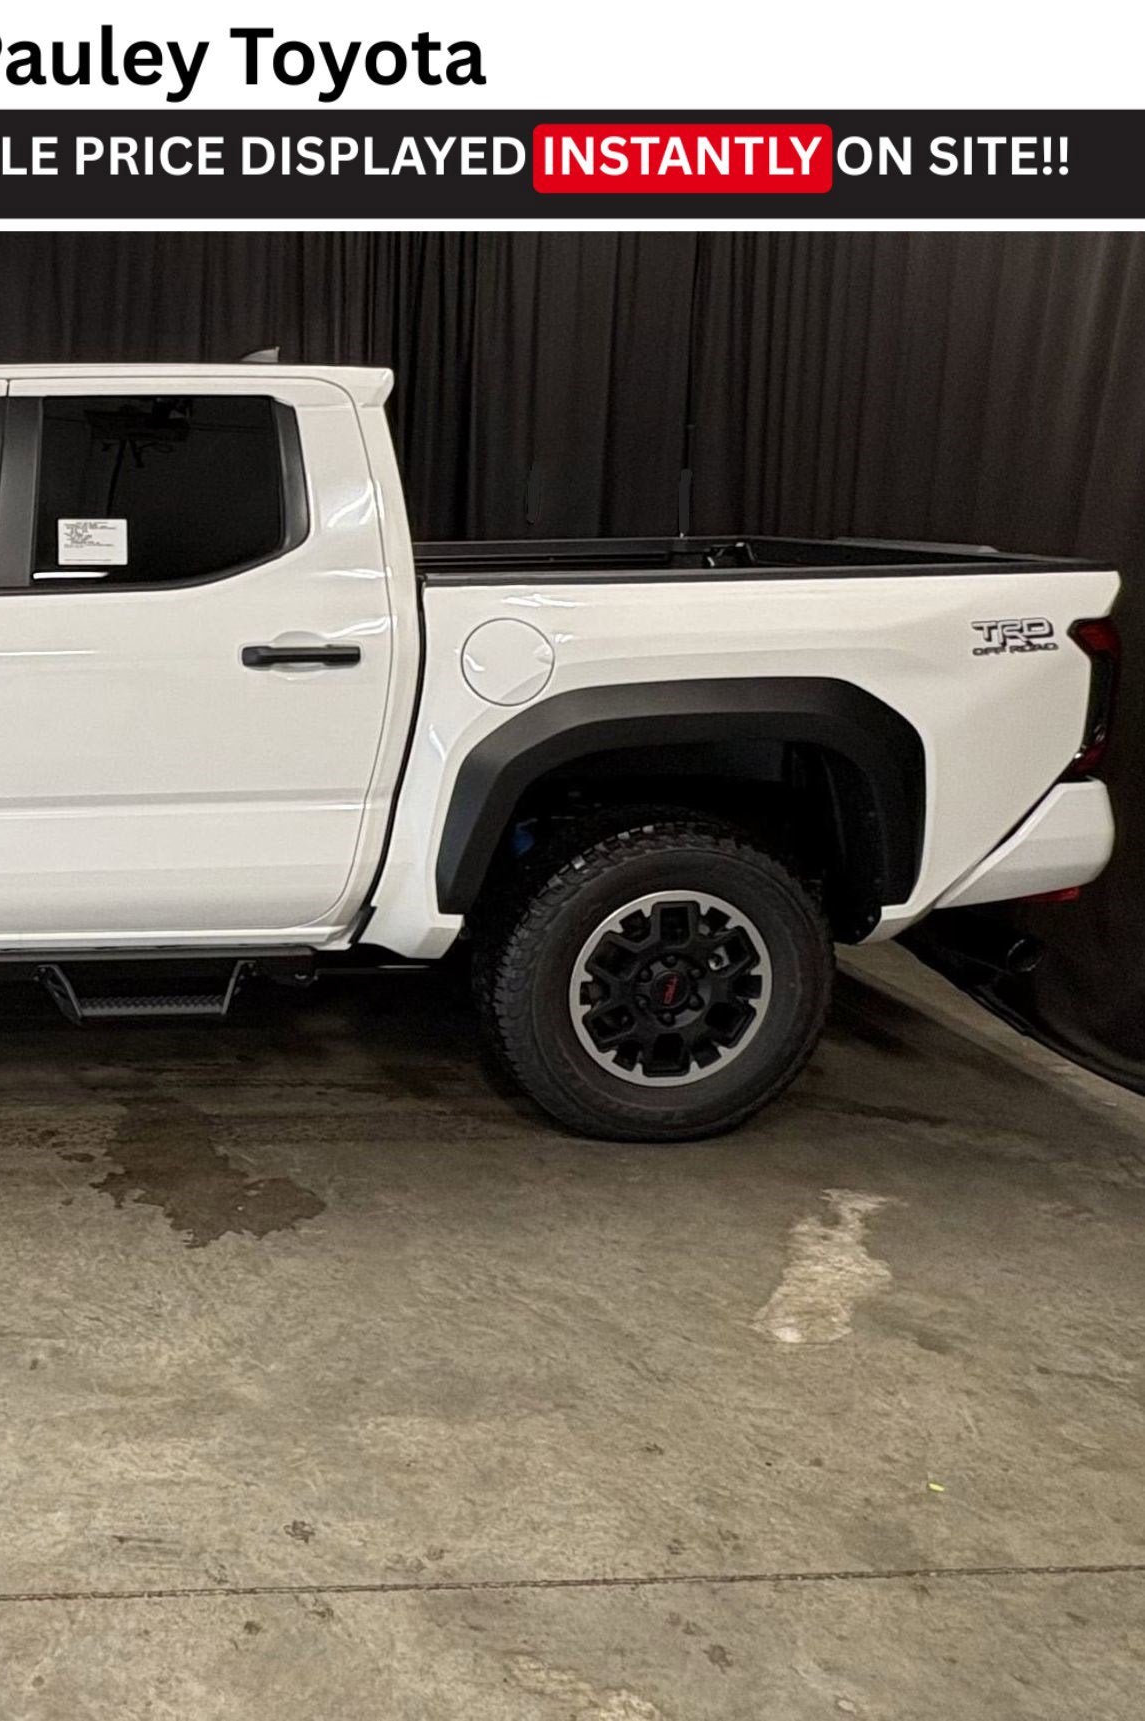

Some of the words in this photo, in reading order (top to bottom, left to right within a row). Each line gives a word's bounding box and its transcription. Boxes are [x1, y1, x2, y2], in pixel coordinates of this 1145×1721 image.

[971, 617, 1054, 648] TRD
[972, 647, 1006, 656] OFF
[1009, 642, 1059, 654] ROAD
